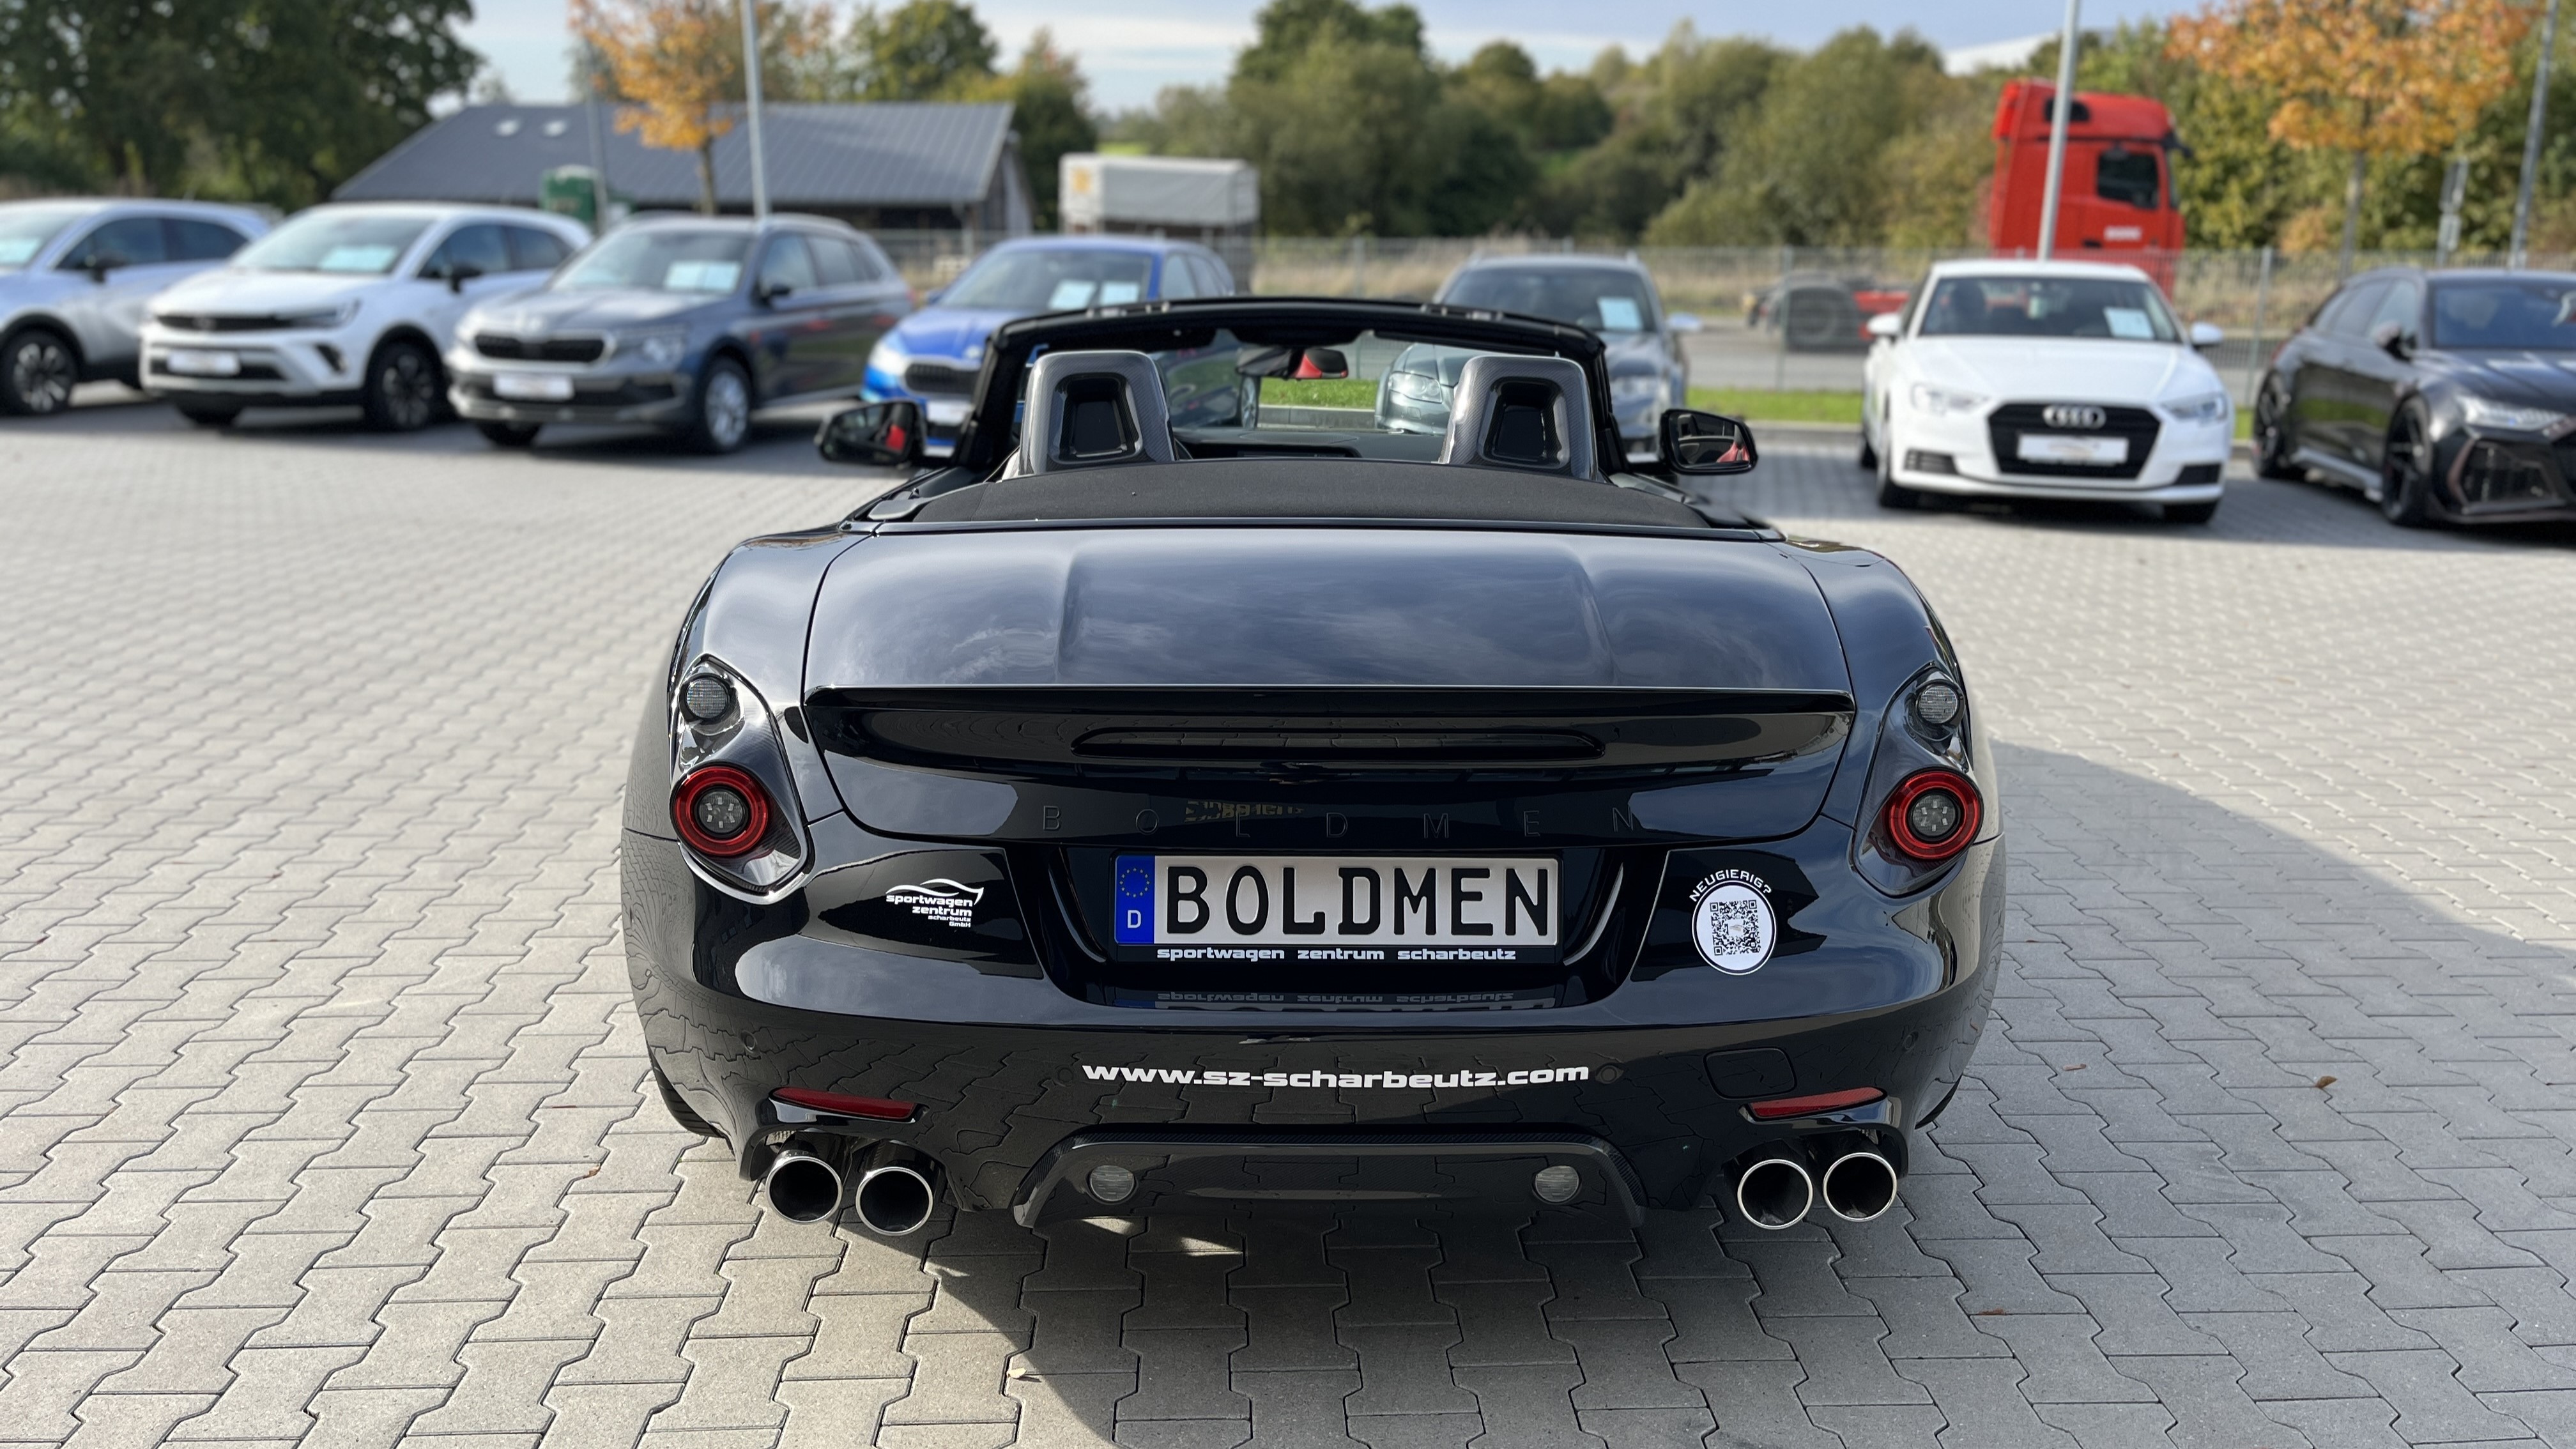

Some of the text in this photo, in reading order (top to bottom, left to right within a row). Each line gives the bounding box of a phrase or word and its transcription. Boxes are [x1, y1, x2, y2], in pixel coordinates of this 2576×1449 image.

[1042, 805, 1634, 839] BOLDMEN
[1689, 869, 1772, 901] NEUGIERIG?
[886, 895, 973, 907] sportwagen
[912, 906, 972, 916] zentrum
[1127, 866, 1548, 936] D BOLDMEN
[1157, 947, 1516, 962] sportwagen zentrum scharbeutz
[1082, 1065, 1589, 1087] www.sz-scharbeutz.com
